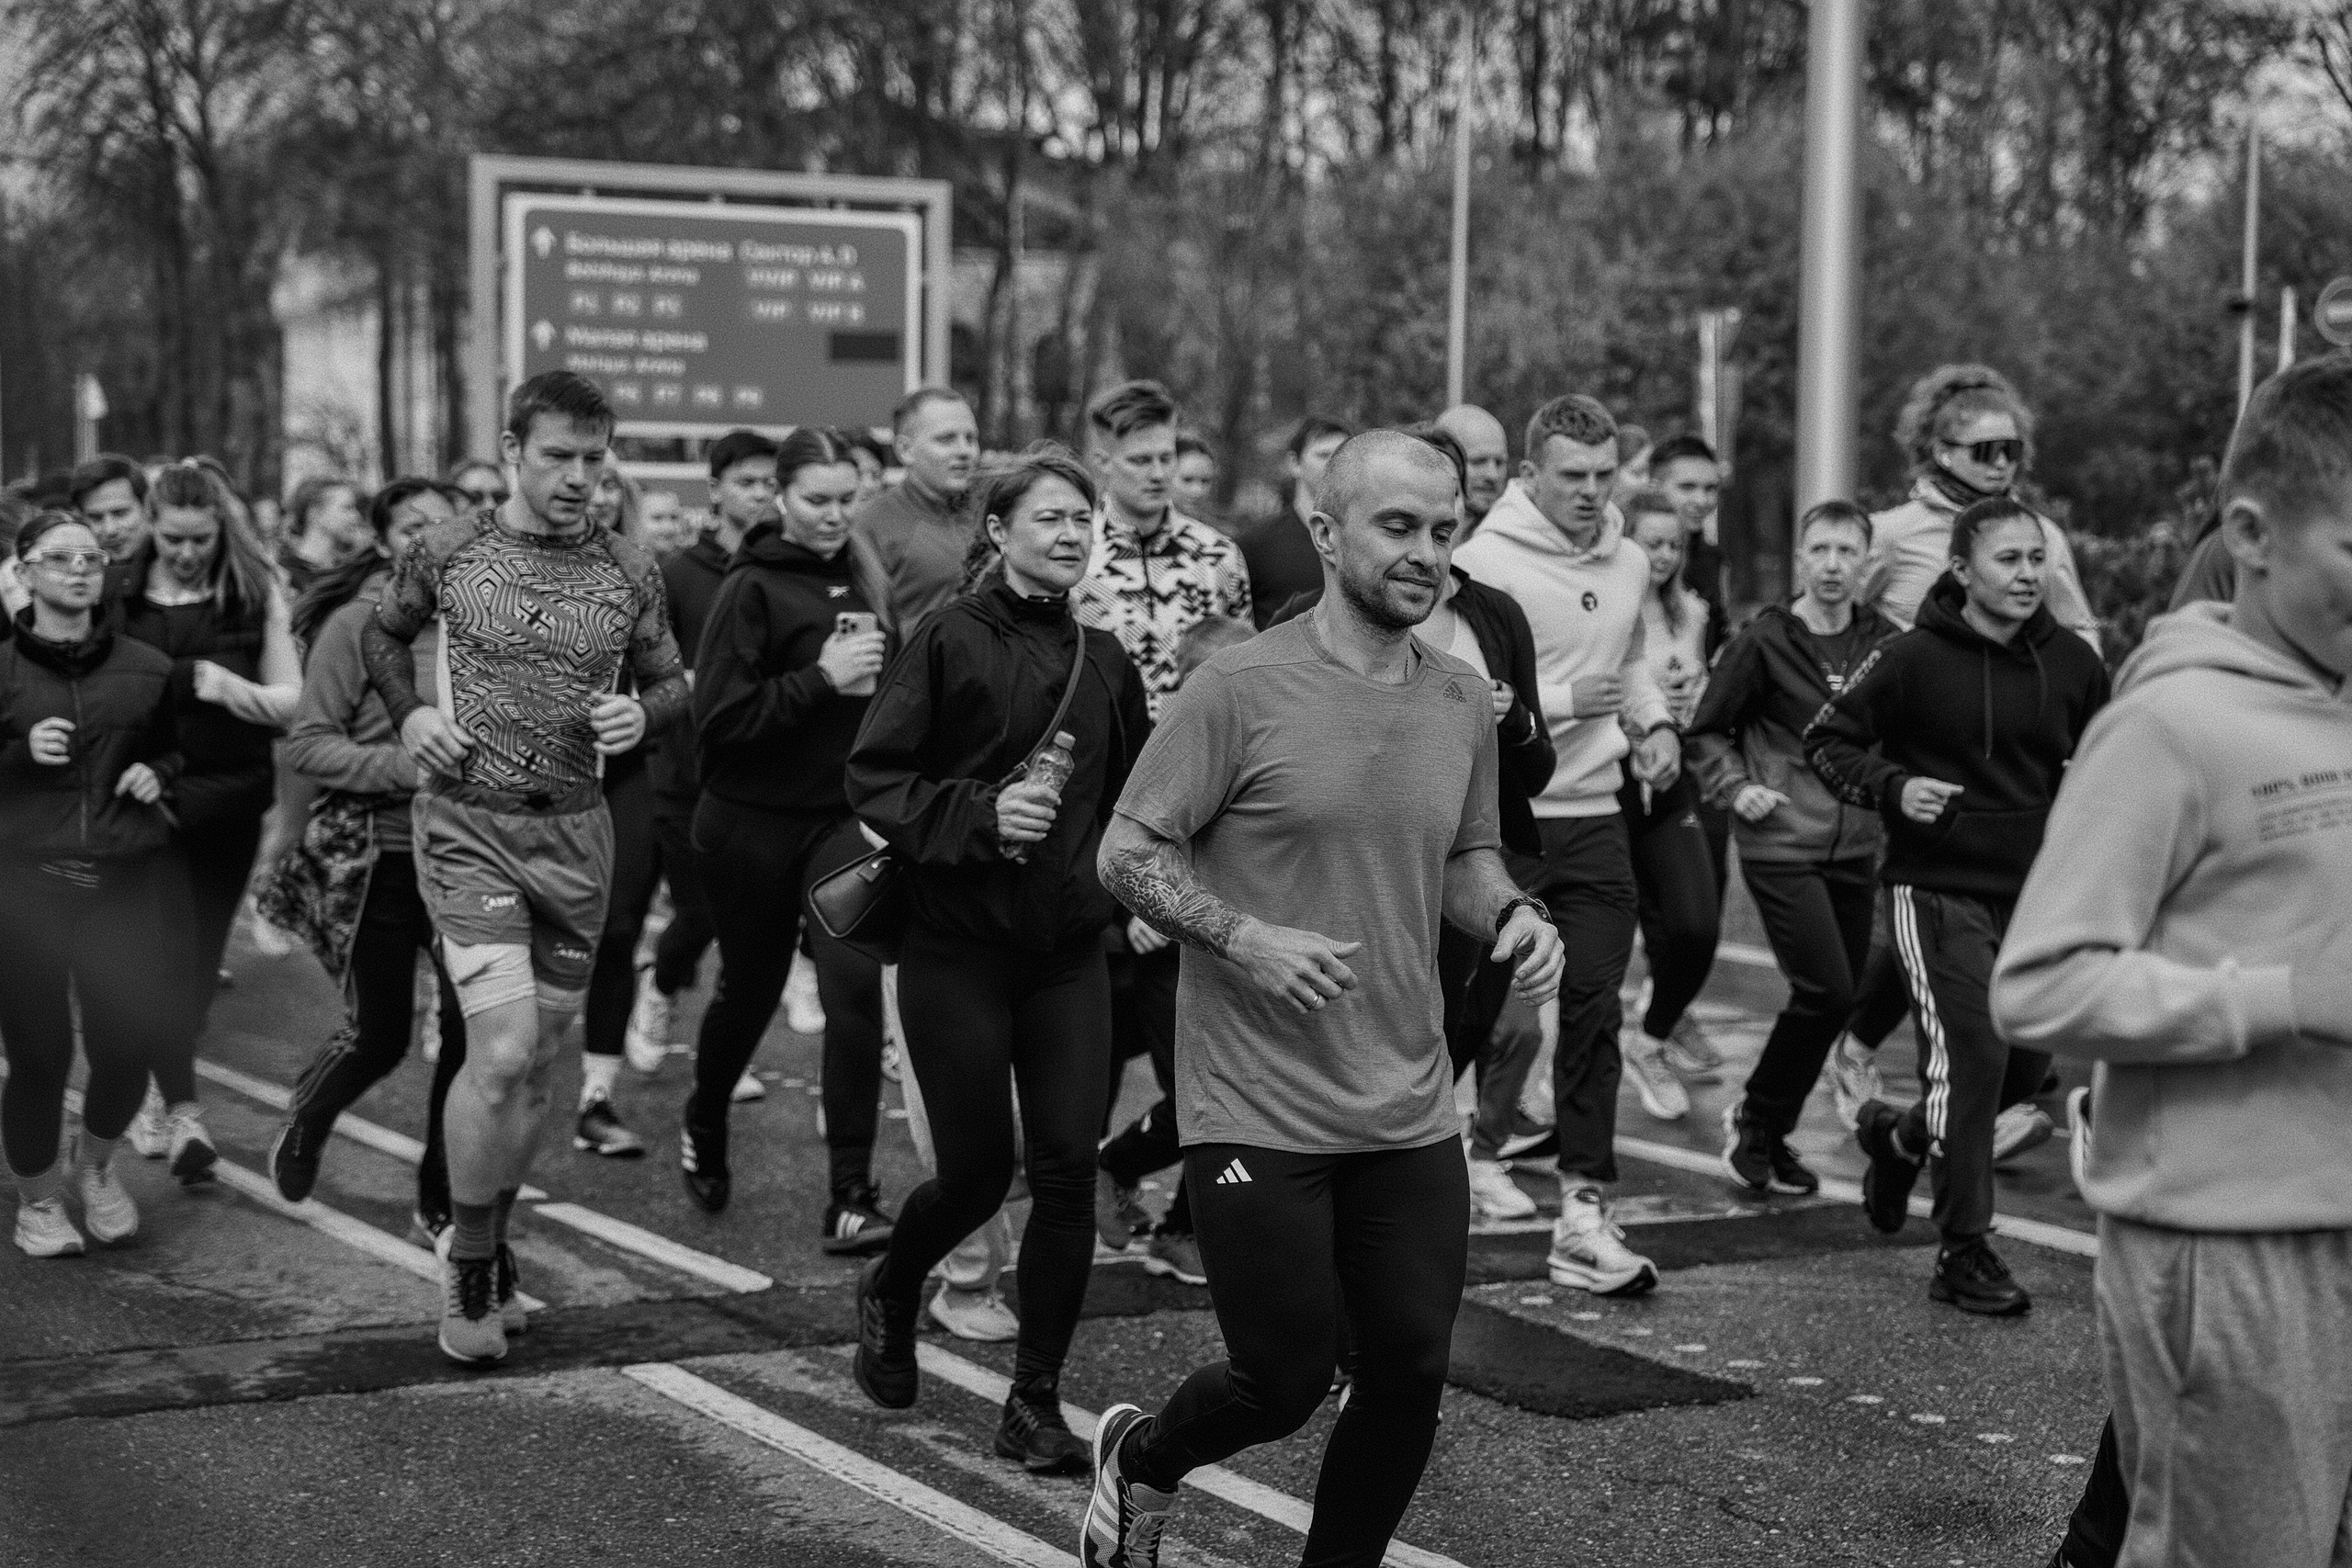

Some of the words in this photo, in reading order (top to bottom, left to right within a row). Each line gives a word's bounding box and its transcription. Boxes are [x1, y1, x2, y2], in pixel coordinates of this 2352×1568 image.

[566, 232, 662, 257] Большая
[666, 239, 732, 262] арена
[740, 240, 816, 266] Сектор
[566, 325, 638, 347] Малая
[640, 331, 707, 352] арена
[1443, 693, 1466, 703] adidas
